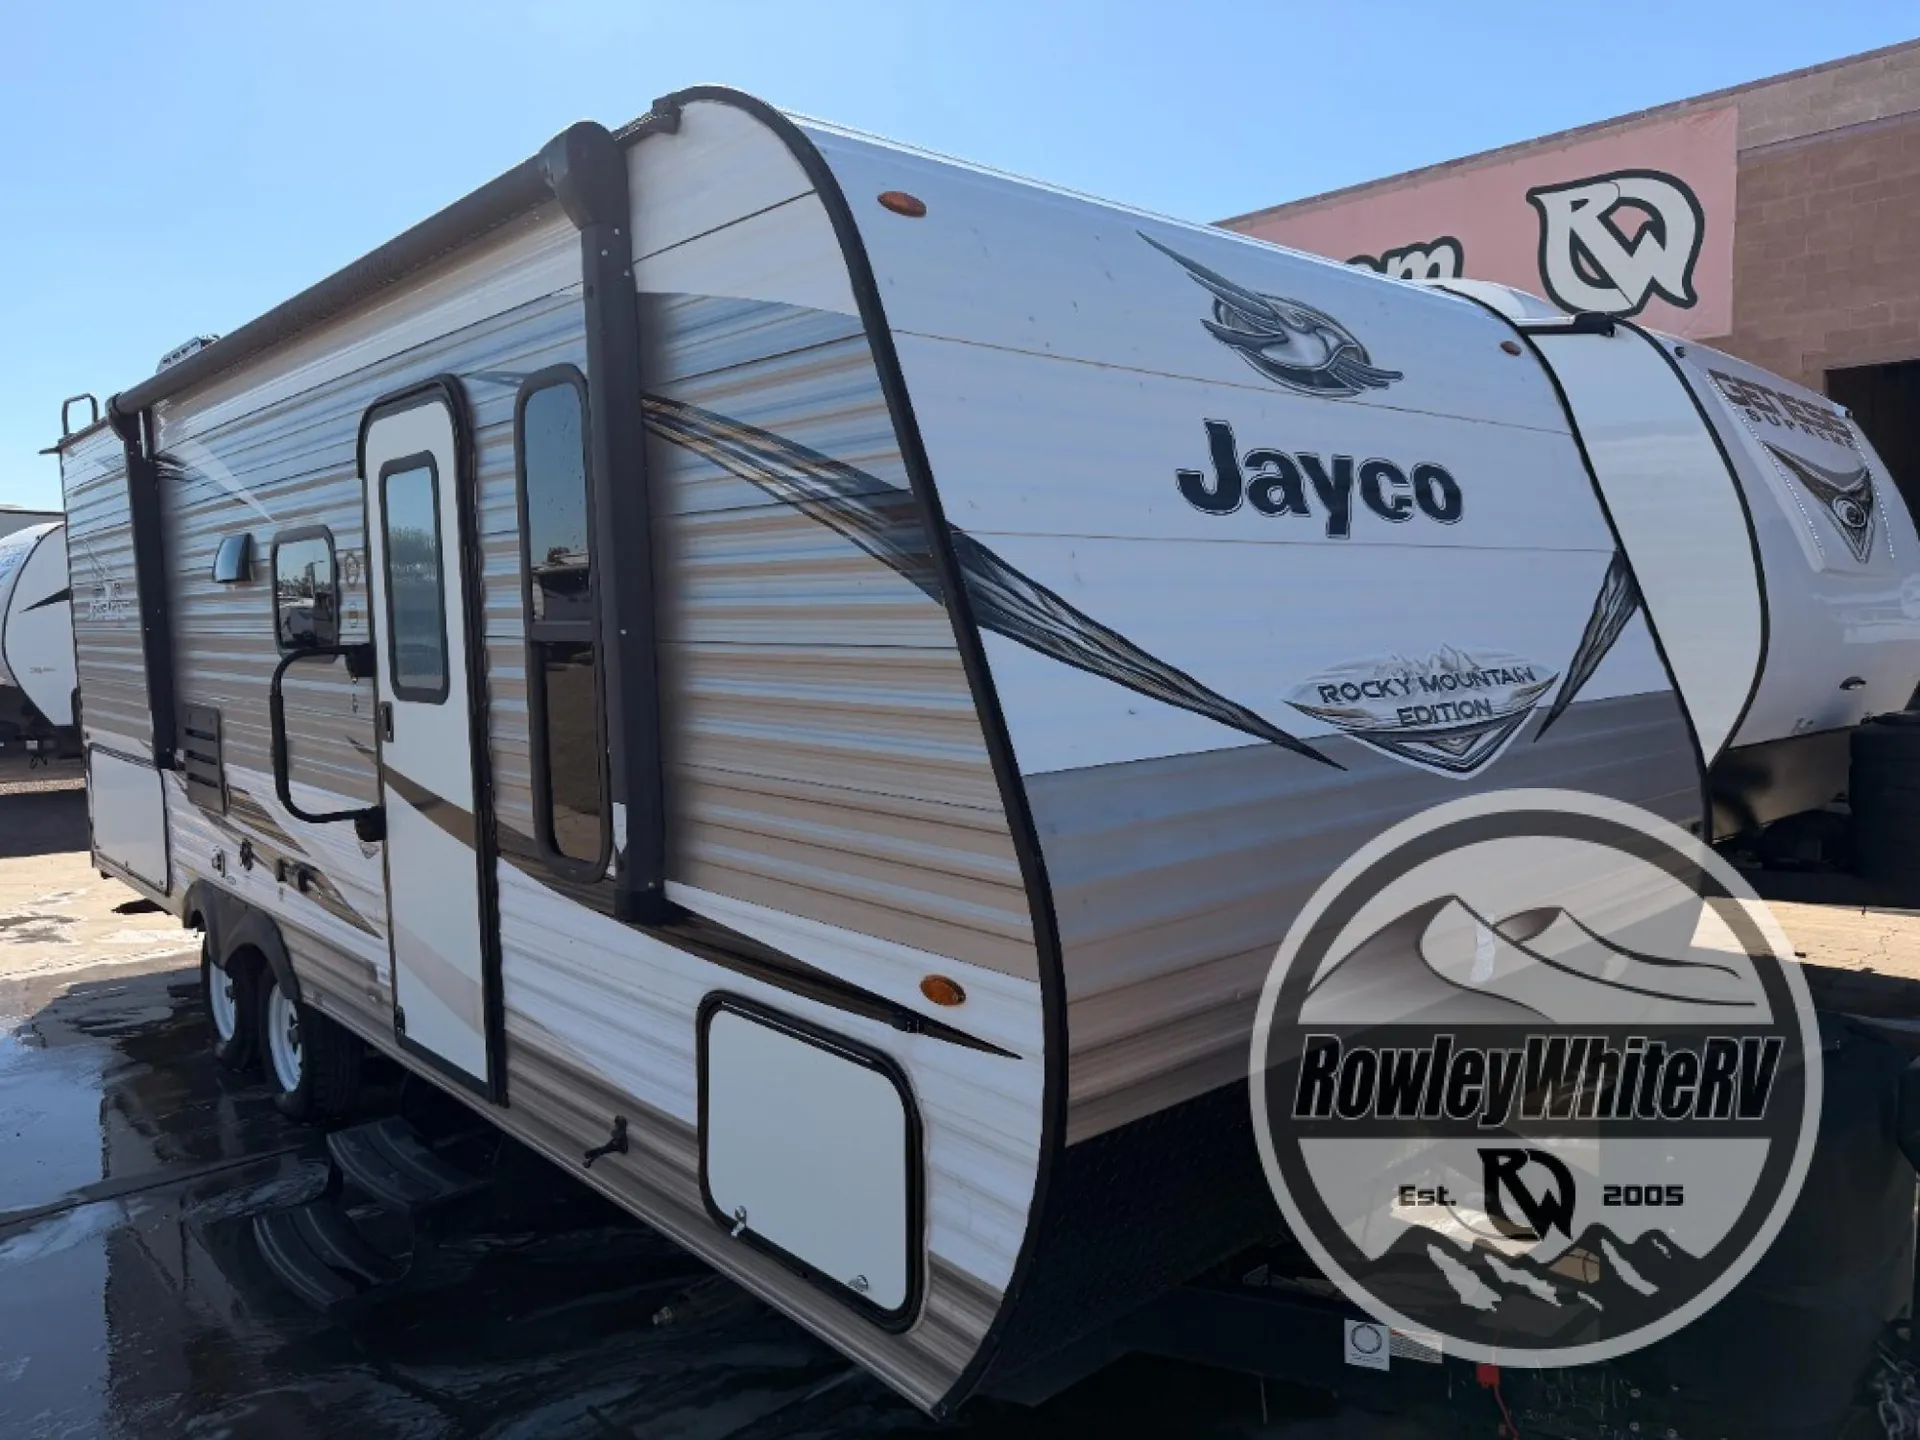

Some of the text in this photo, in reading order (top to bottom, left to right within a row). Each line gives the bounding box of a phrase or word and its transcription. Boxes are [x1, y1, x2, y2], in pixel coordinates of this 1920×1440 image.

[1347, 236, 1463, 279] m
[1176, 417, 1463, 538] Jayco
[1317, 666, 1536, 704] ROCKY MOUNTAIN
[1397, 698, 1493, 727] EDITION
